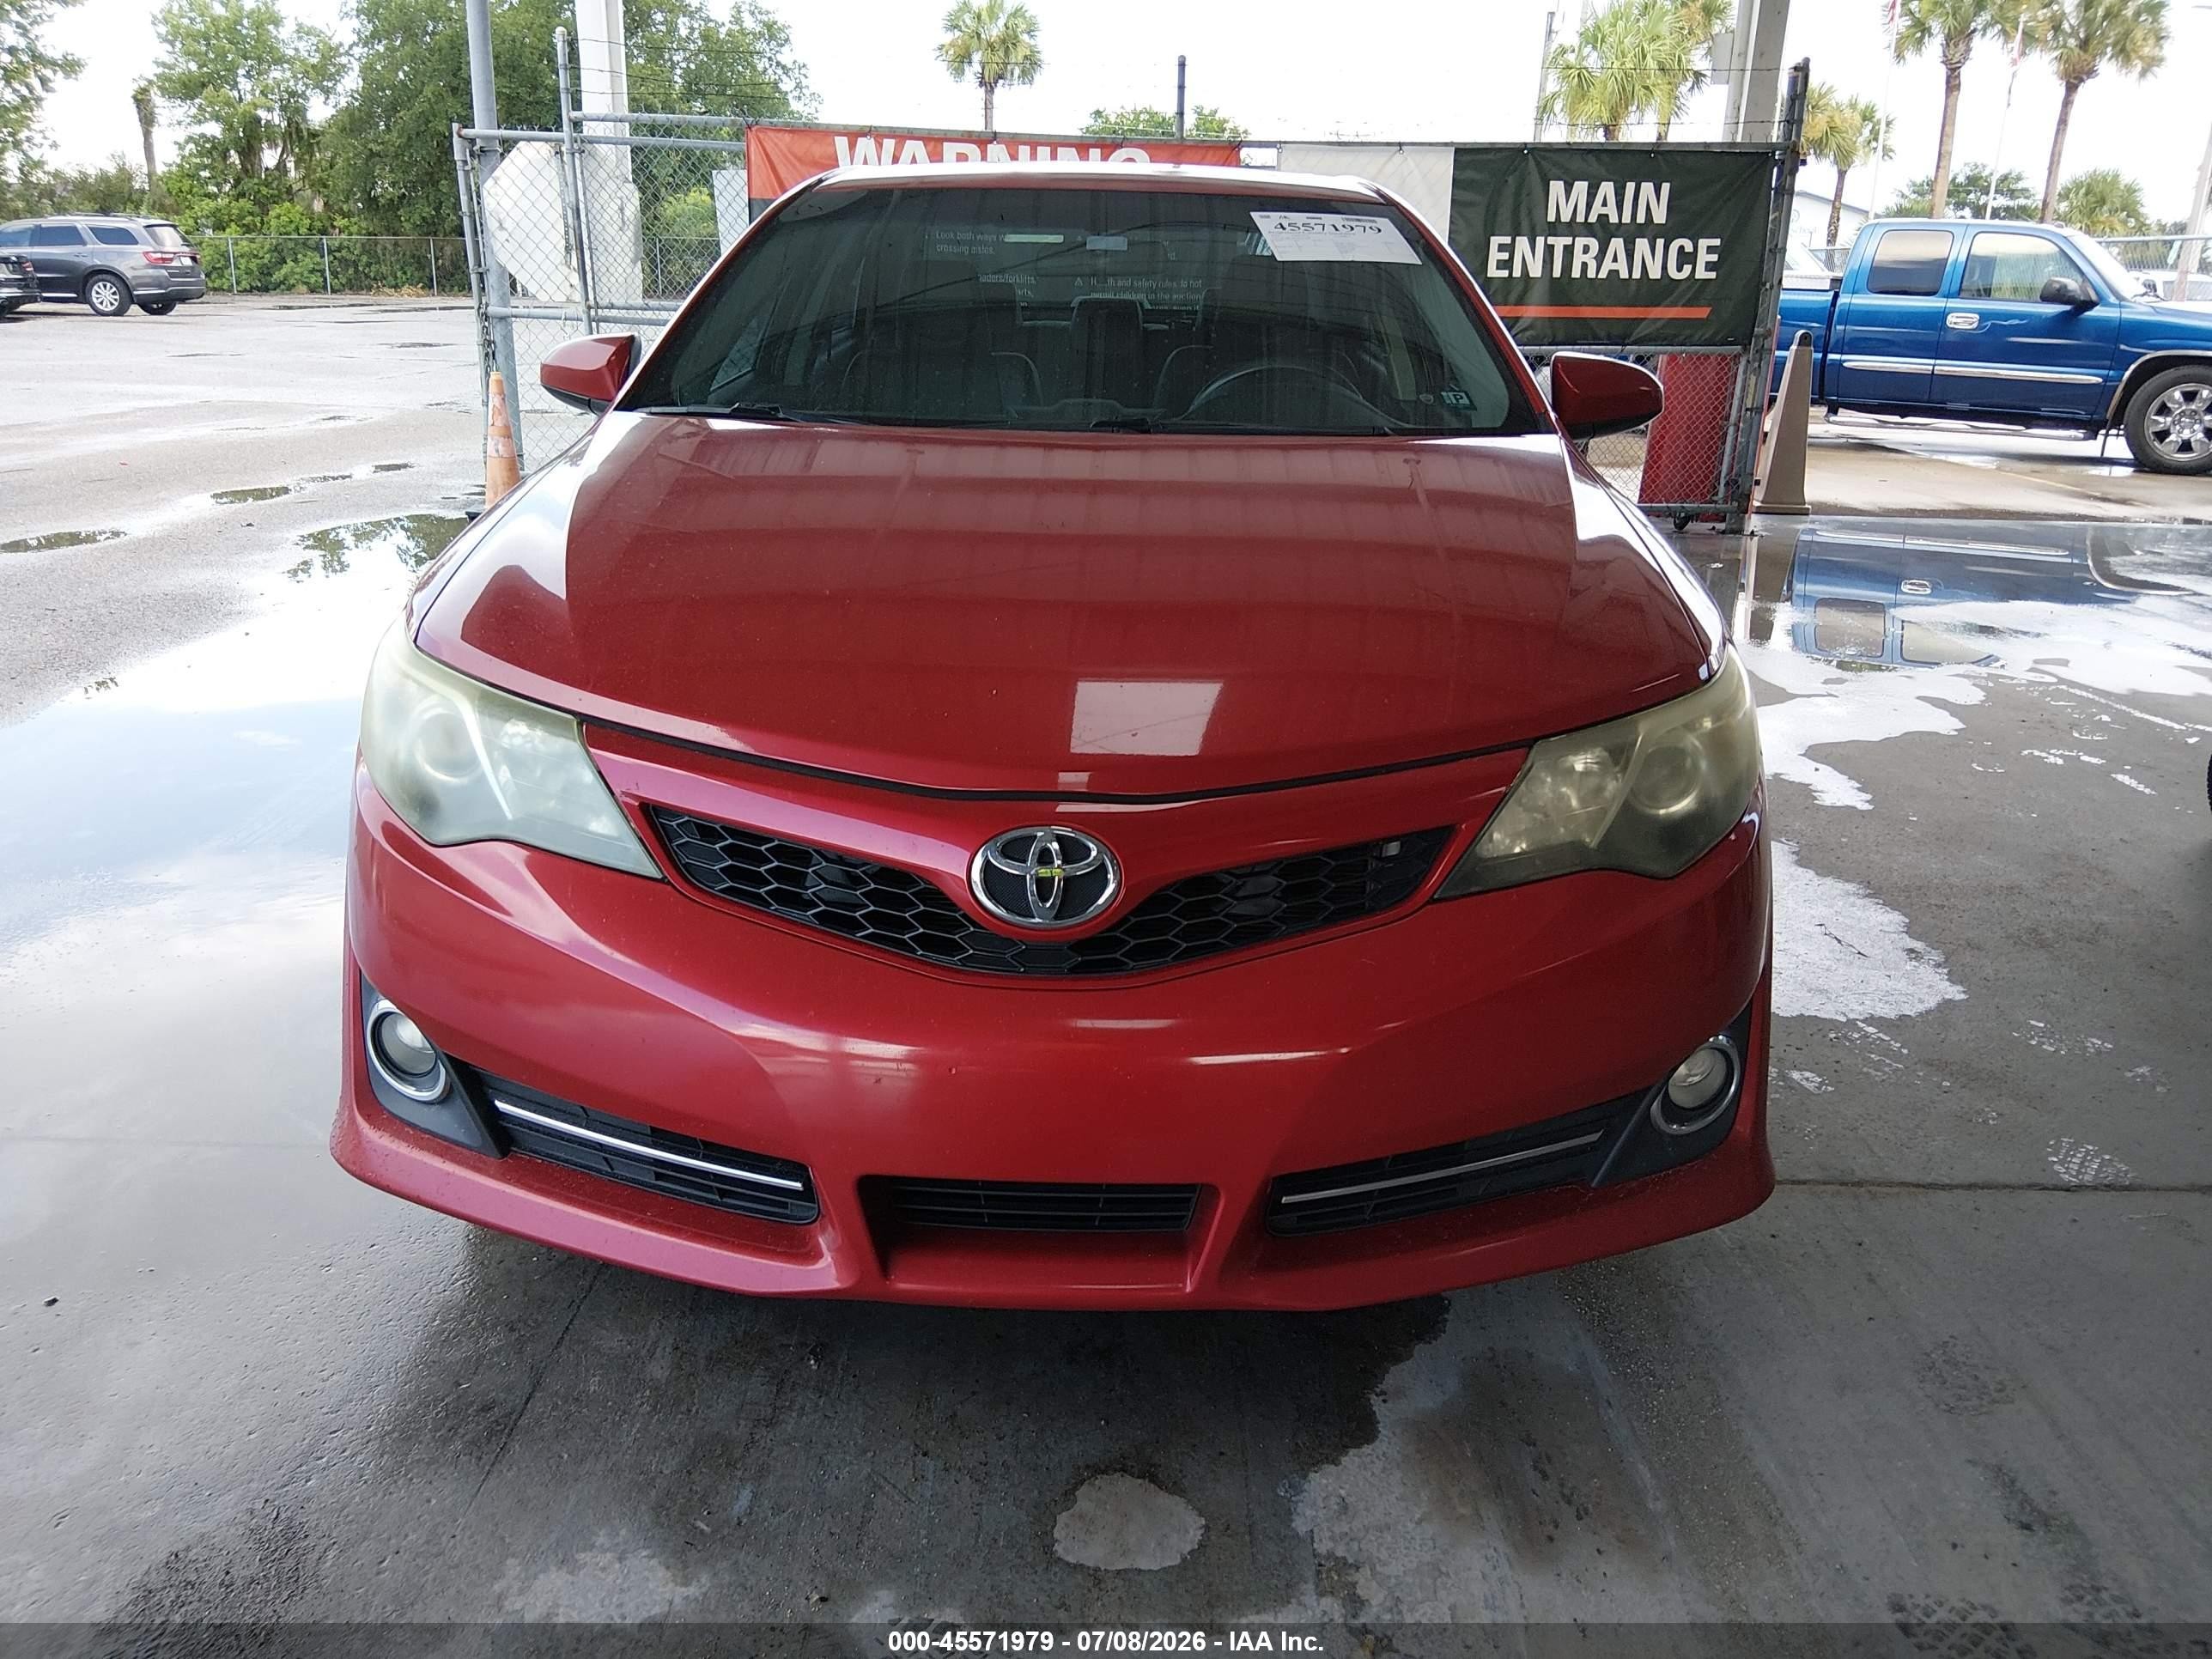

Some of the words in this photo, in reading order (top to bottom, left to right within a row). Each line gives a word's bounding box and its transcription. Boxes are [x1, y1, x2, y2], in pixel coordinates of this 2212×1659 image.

[1547, 180, 1671, 224] MAIN
[1273, 222, 1382, 234] 45571979
[957, 231, 975, 240] both
[976, 234, 997, 243] ways
[936, 245, 970, 256] crossing
[1486, 234, 1722, 279] ENTRANCE
[1091, 276, 1115, 286] Hth
[1117, 277, 1132, 287] and
[1133, 277, 1157, 289] safety
[1189, 279, 1202, 289] not
